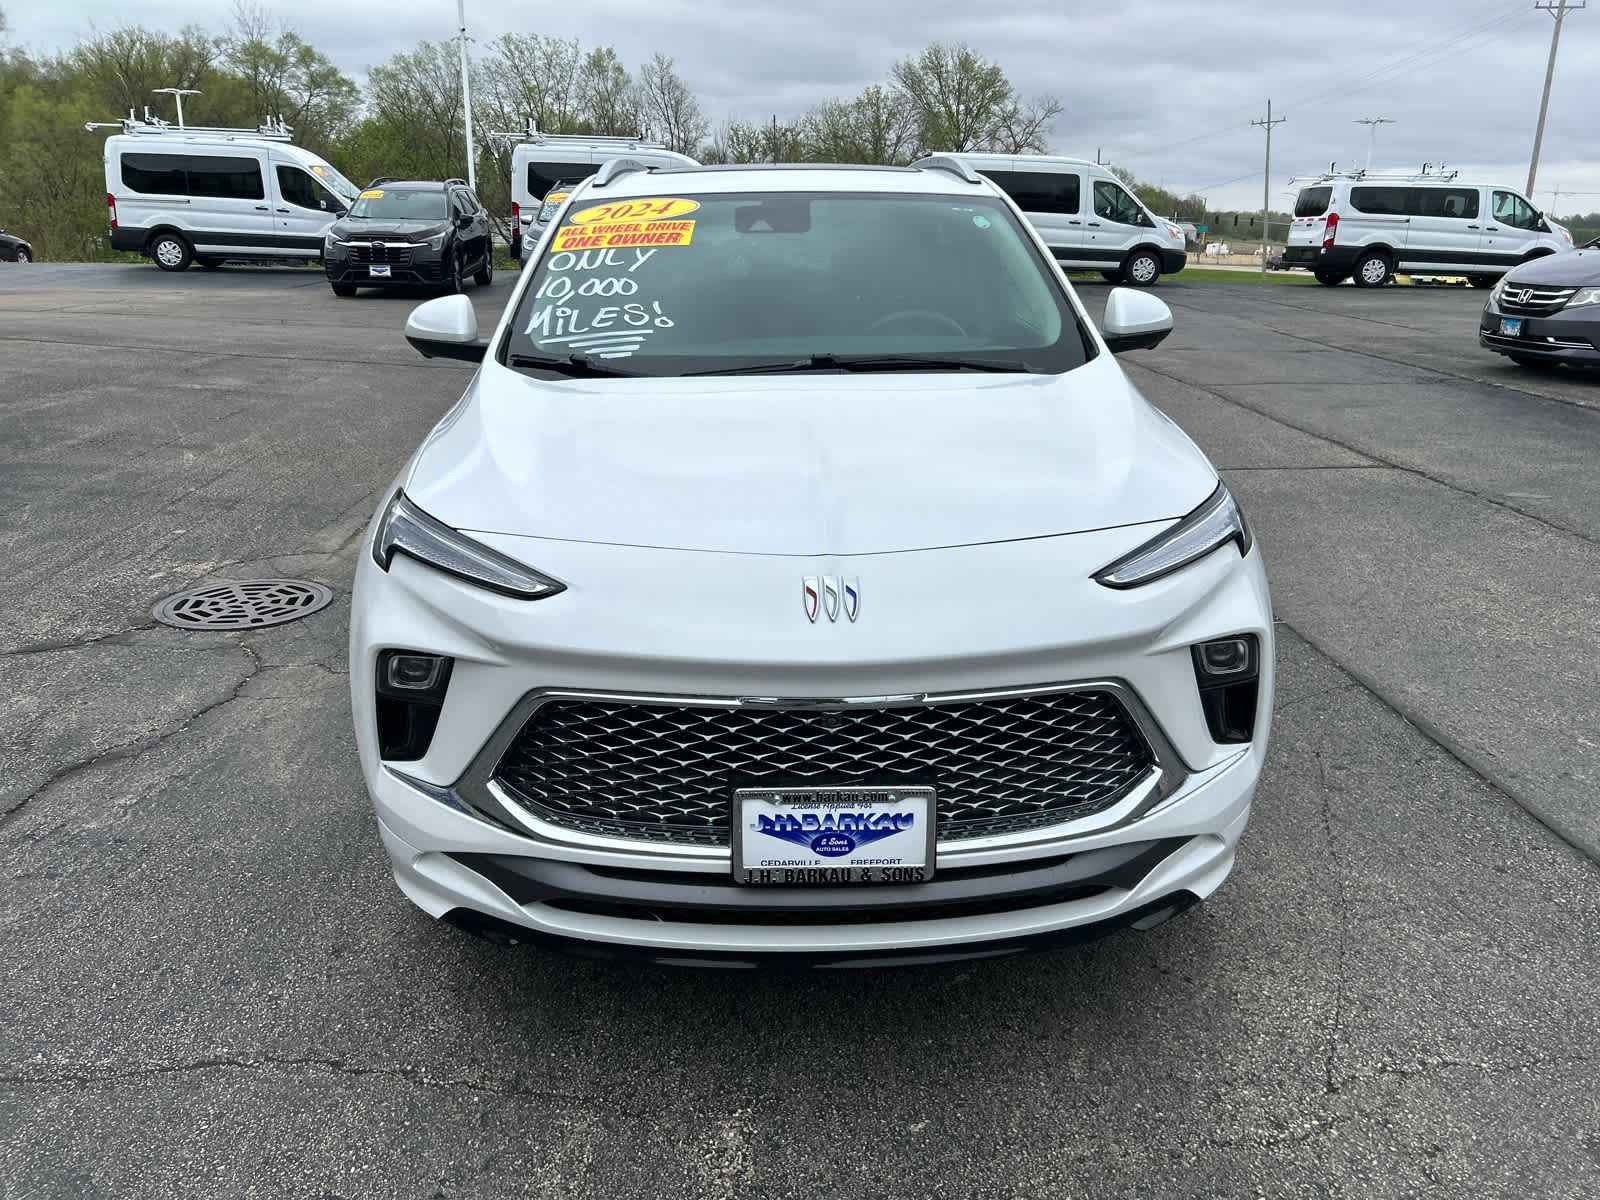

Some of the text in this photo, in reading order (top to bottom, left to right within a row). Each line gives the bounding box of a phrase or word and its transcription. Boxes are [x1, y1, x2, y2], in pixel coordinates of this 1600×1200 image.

[589, 200, 676, 222] 2024
[560, 221, 691, 237] ALL WHEEL DRIVE
[561, 232, 684, 249] ONE OWNER
[547, 247, 659, 272] ONLY
[535, 276, 639, 306] 10,000
[782, 791, 889, 803] www.barkau.com
[828, 837, 849, 846] Sons
[760, 858, 903, 867] CEDARVILLE FREEPORT
[784, 867, 850, 883] BARKAU
[860, 867, 872, 881] &
[880, 866, 925, 882] SONS
